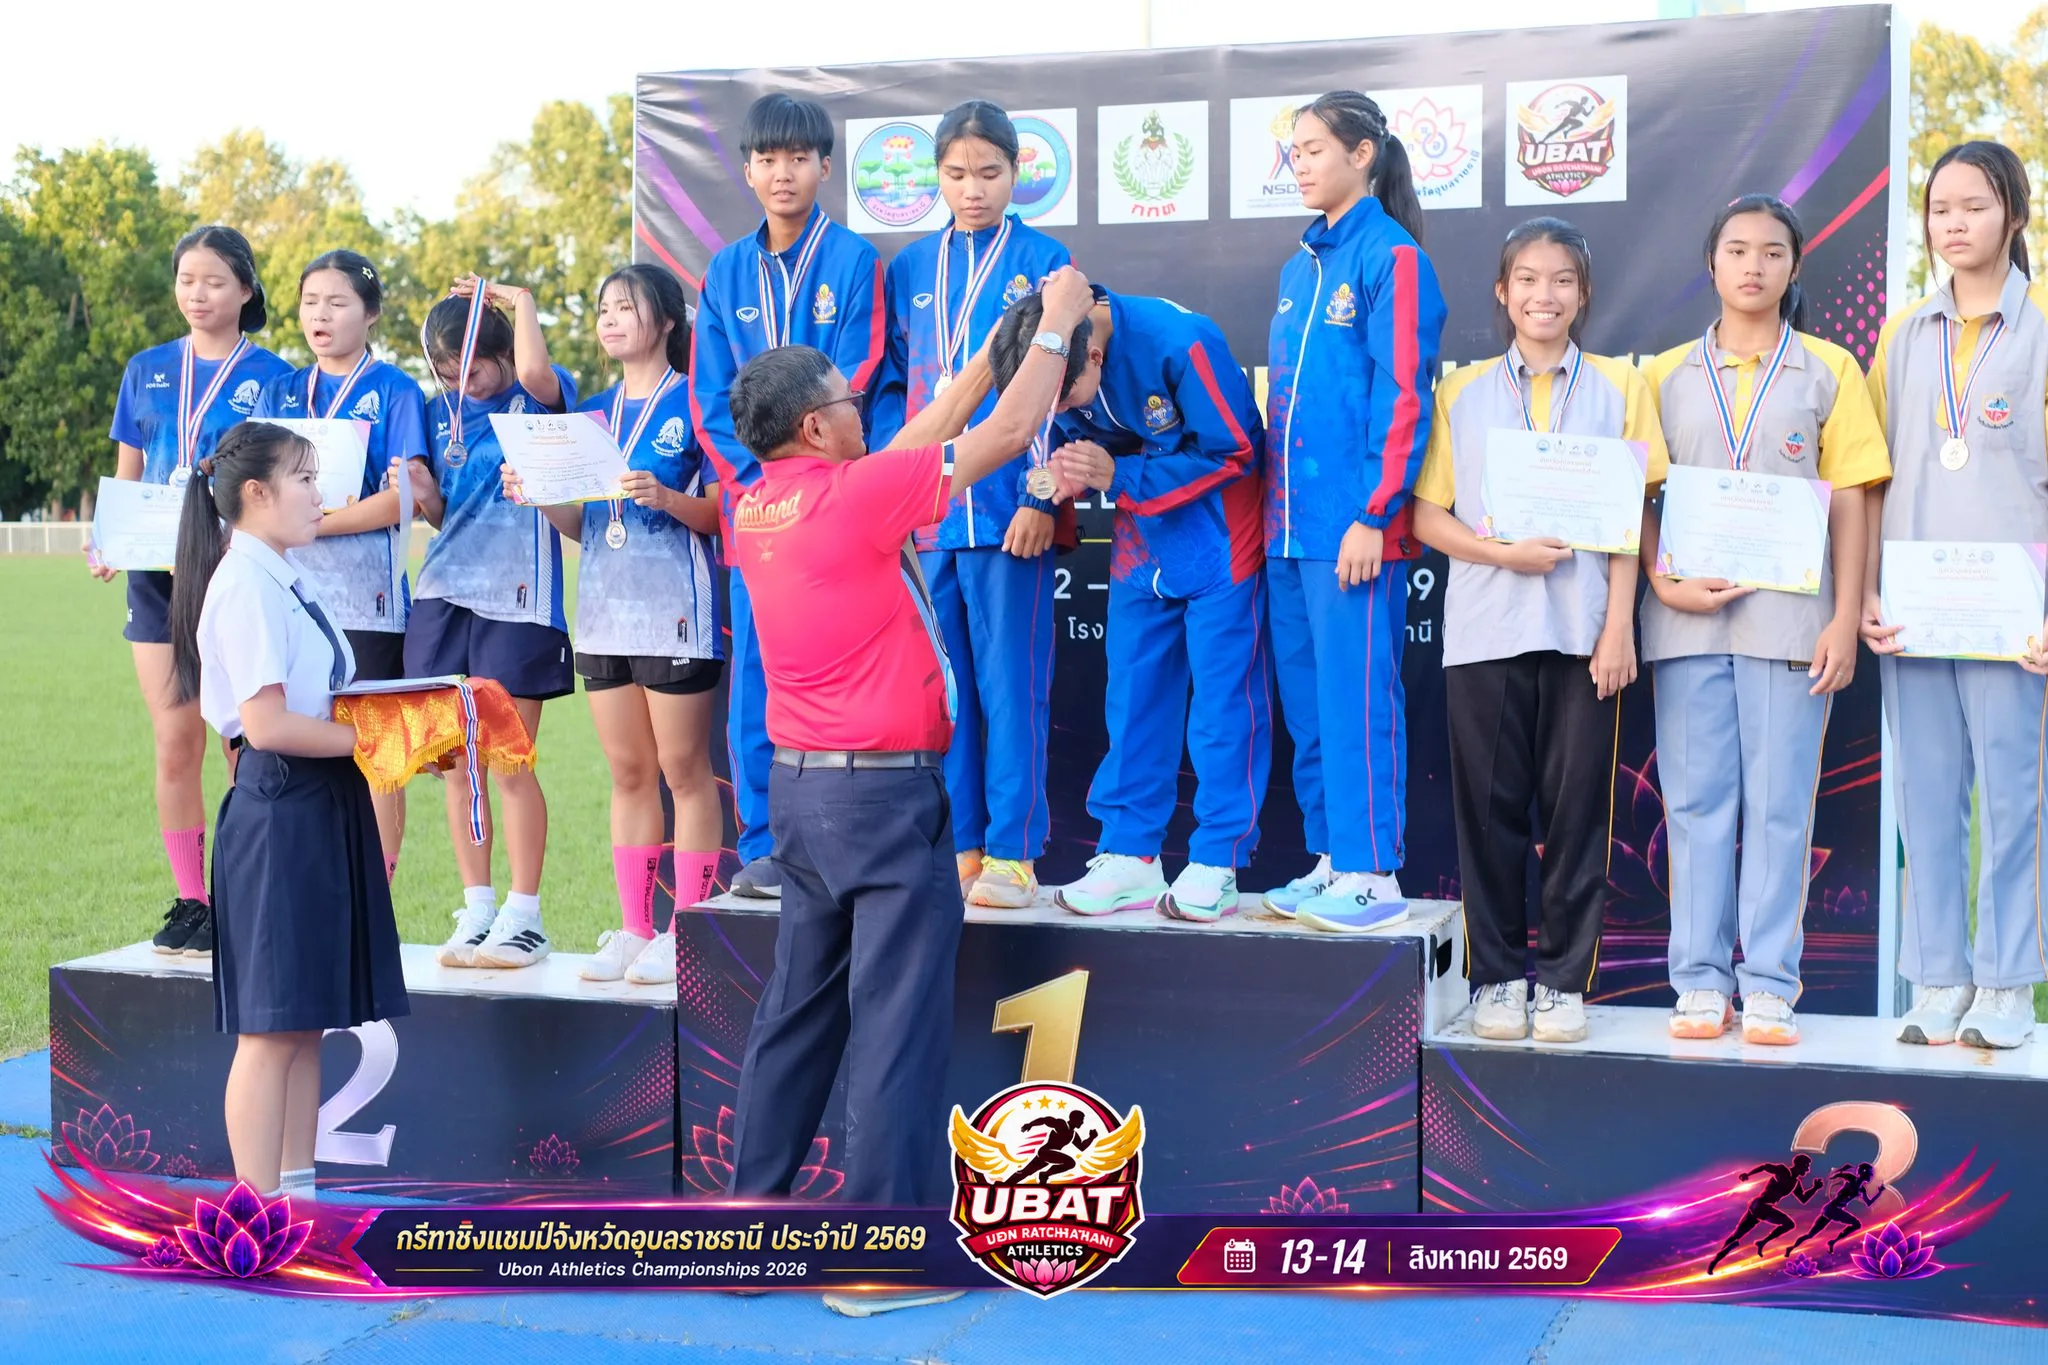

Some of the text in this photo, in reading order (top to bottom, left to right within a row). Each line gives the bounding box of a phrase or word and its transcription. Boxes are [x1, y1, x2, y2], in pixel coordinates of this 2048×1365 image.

[1524, 140, 1609, 166] UBAT
[1262, 183, 1301, 196] NSD
[313, 1019, 399, 1167] 2
